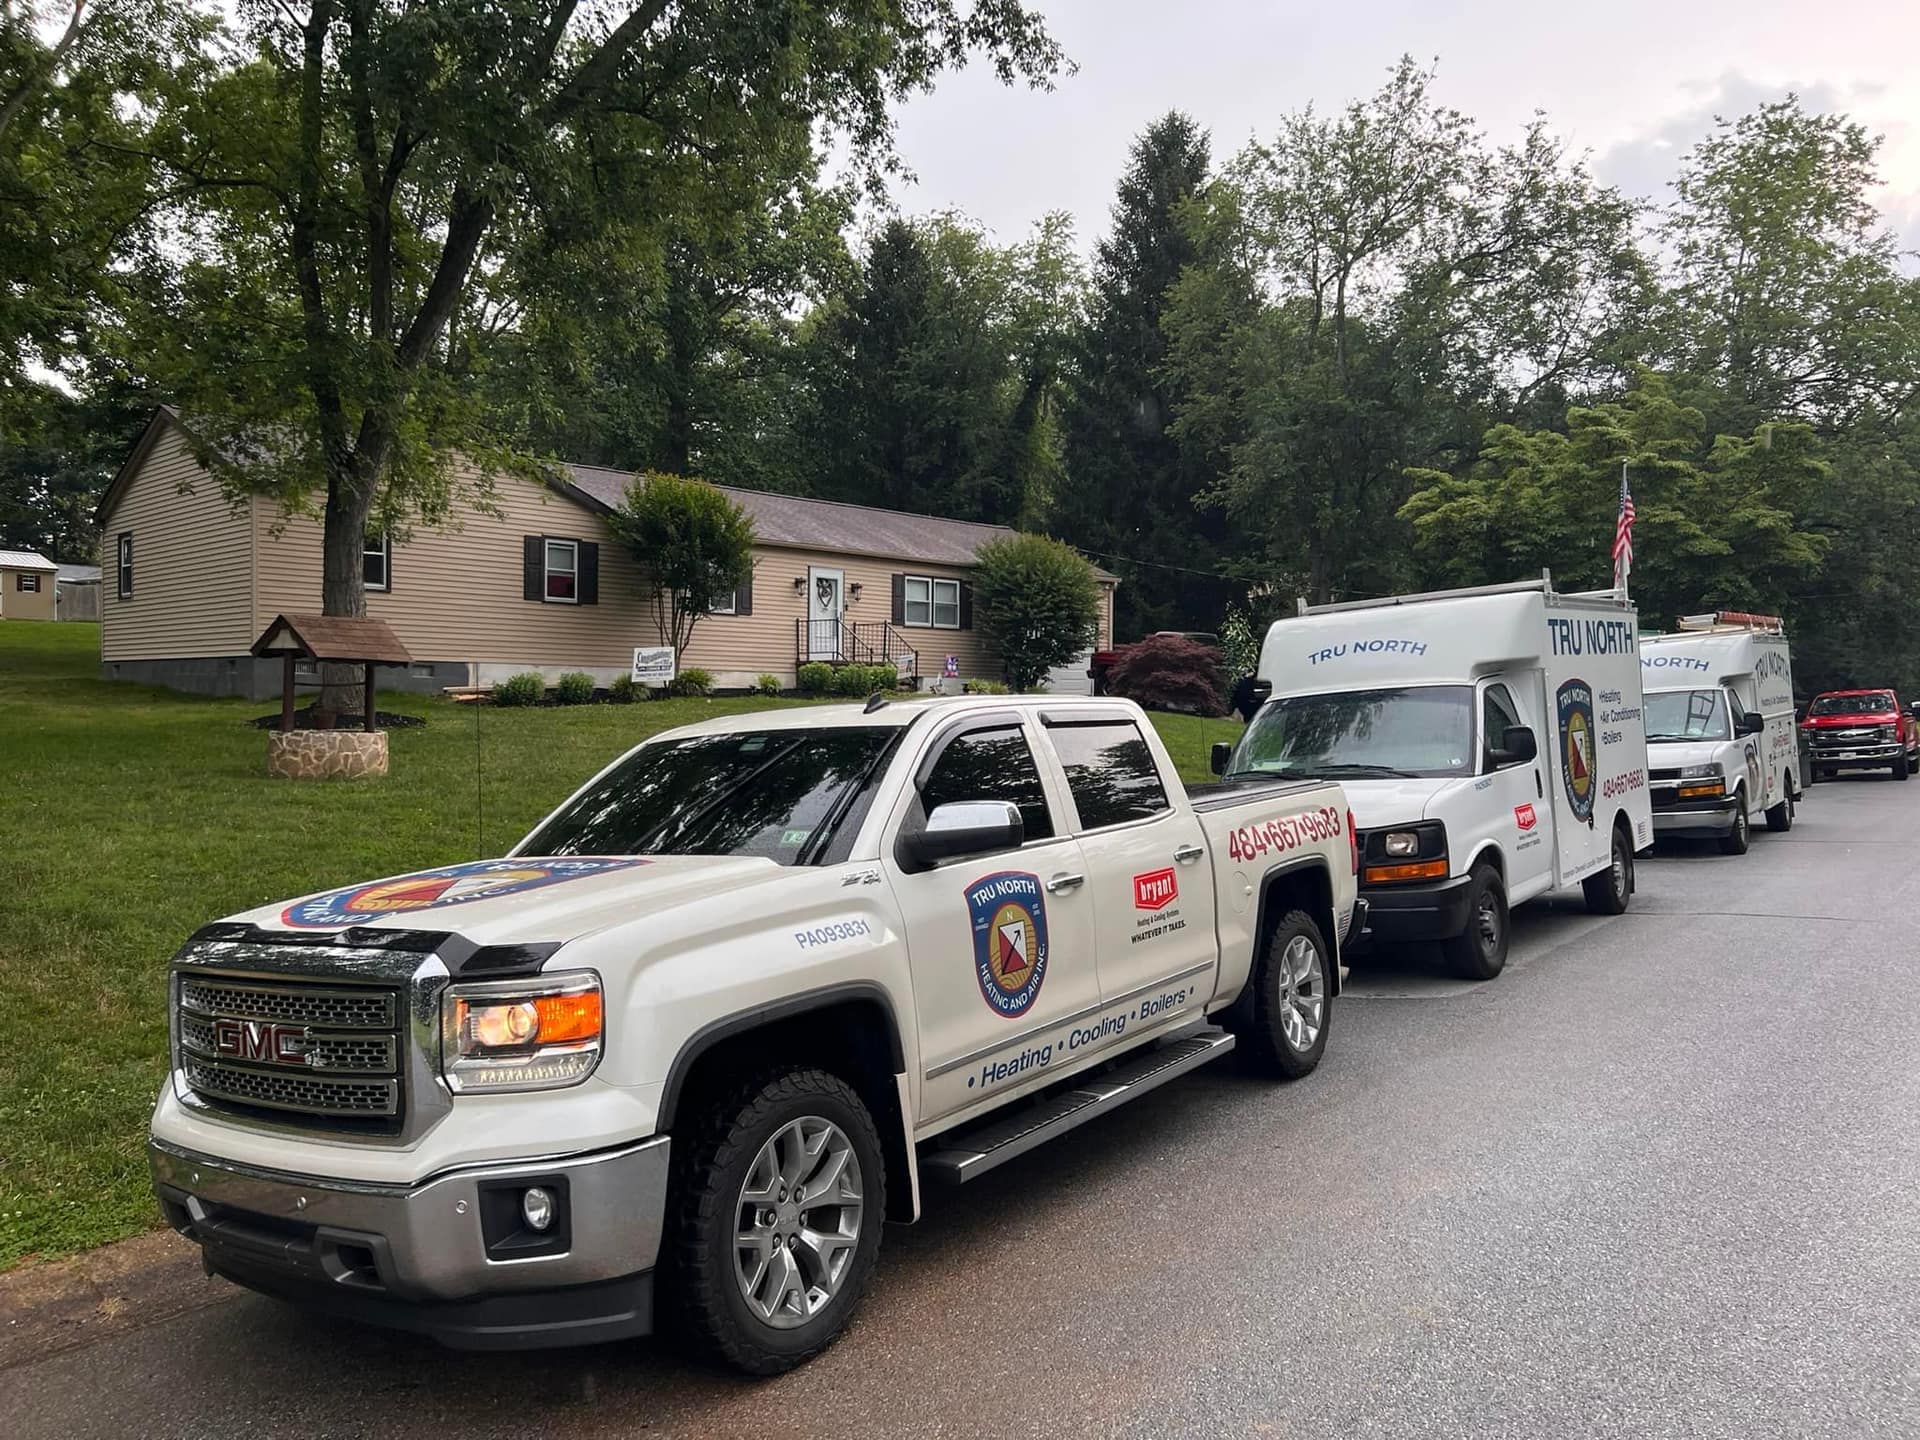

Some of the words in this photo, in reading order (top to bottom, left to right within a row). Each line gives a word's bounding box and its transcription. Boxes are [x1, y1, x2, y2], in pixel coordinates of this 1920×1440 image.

[1547, 617, 1582, 656] TRU
[1585, 619, 1635, 656] NORTH
[1308, 644, 1346, 665] TRU
[1353, 639, 1428, 657] NORTH
[1640, 656, 1710, 672] NORTH
[1560, 690, 1572, 708] TRU
[1572, 687, 1591, 706] NORTH
[972, 883, 996, 907] TRU
[995, 879, 1037, 896] NORTH
[1140, 874, 1173, 901] bryant
[1006, 911, 1013, 921] N
[794, 919, 871, 949] PA093831
[1131, 926, 1162, 944] WHATEVER
[980, 962, 1009, 1010] HEATING
[1009, 992, 1028, 1010] AND
[1028, 974, 1040, 998] AIR
[1038, 943, 1046, 973] INC.
[215, 1018, 306, 1064] GMC
[980, 1044, 1052, 1087] Heating
[1068, 1013, 1126, 1050] Cooling
[1139, 988, 1186, 1020] Boilers
